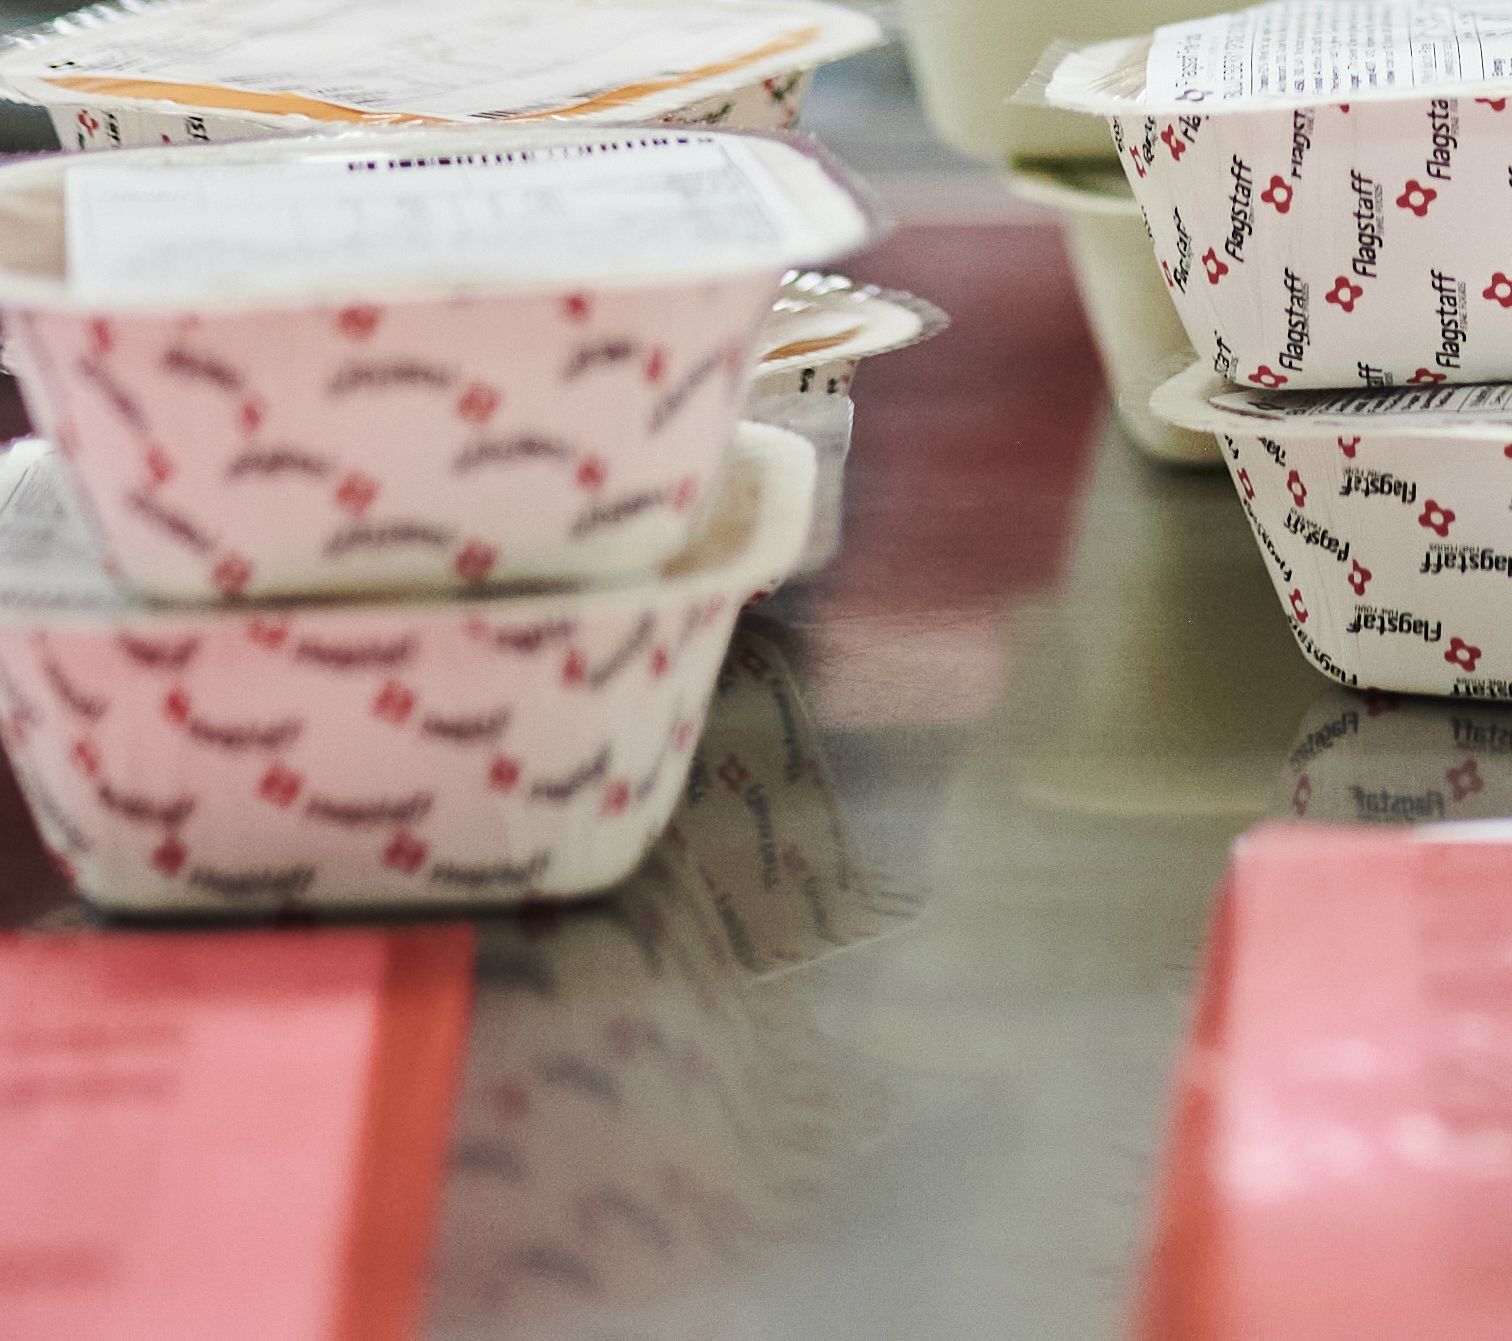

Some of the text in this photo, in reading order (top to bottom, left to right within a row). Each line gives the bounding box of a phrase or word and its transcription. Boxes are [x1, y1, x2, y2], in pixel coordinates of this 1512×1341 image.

[1426, 99, 1458, 180] Flagsta
[1225, 154, 1253, 263] Flagstaff
[1351, 169, 1383, 278] Flagstaff
[1279, 267, 1310, 371] Flagstaff
[1431, 269, 1466, 368] Flagstaff
